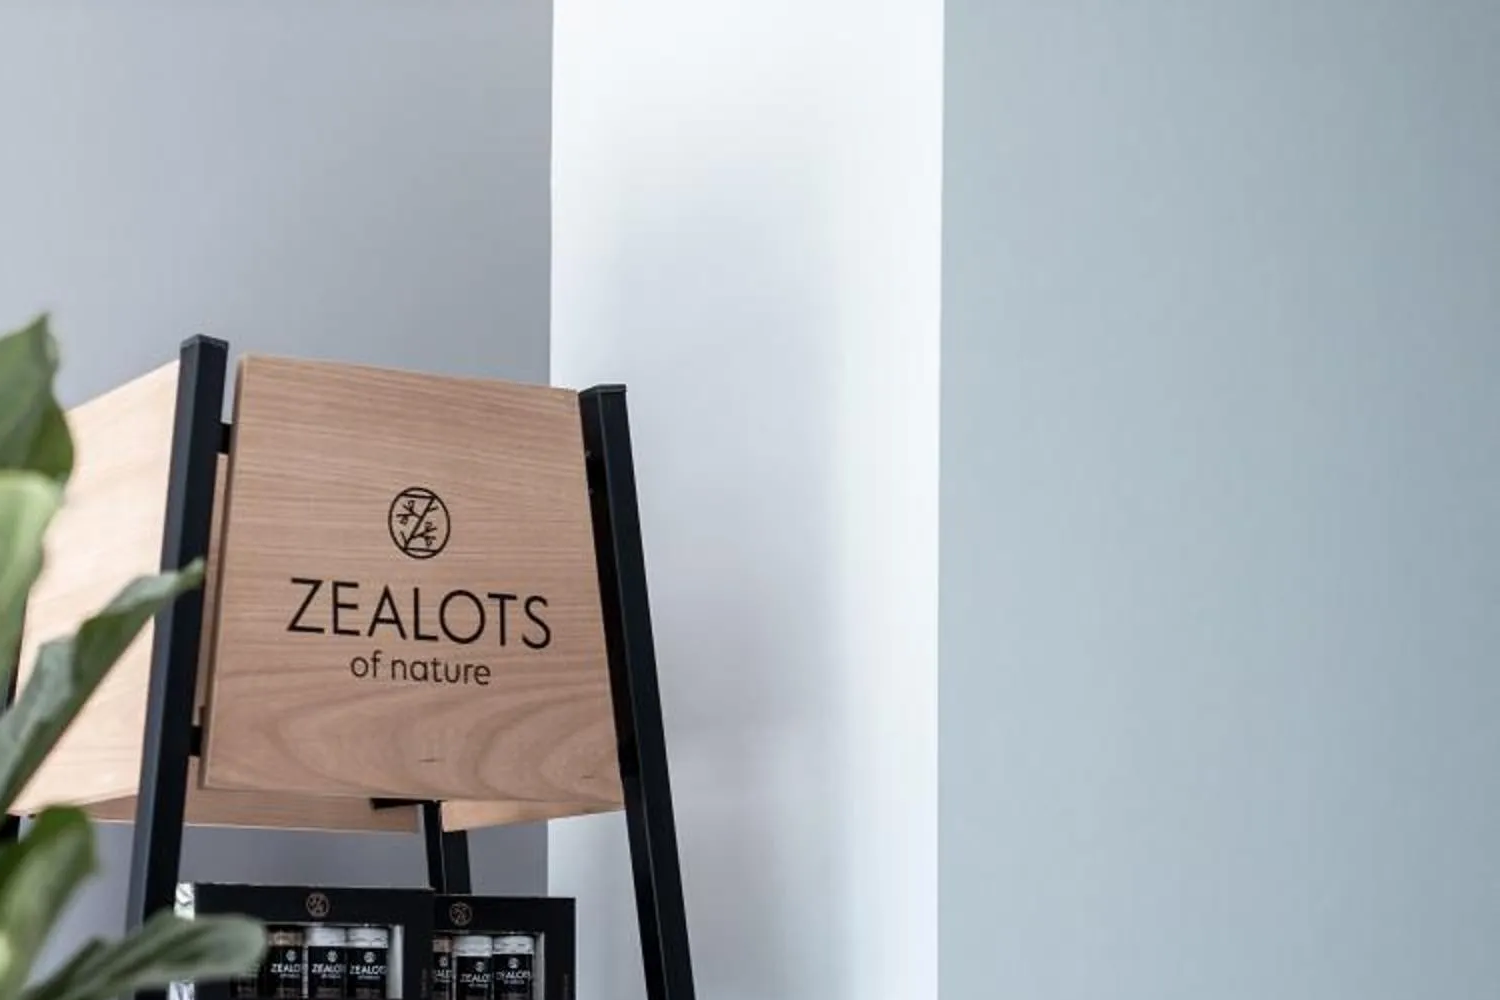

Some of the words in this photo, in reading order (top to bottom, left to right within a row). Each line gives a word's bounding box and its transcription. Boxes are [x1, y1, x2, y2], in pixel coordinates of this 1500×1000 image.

[287, 577, 552, 650] ZEALOTS
[350, 649, 383, 679] of
[390, 654, 492, 685] nature
[270, 963, 301, 974] ZEALO
[311, 963, 347, 974] ZEALO
